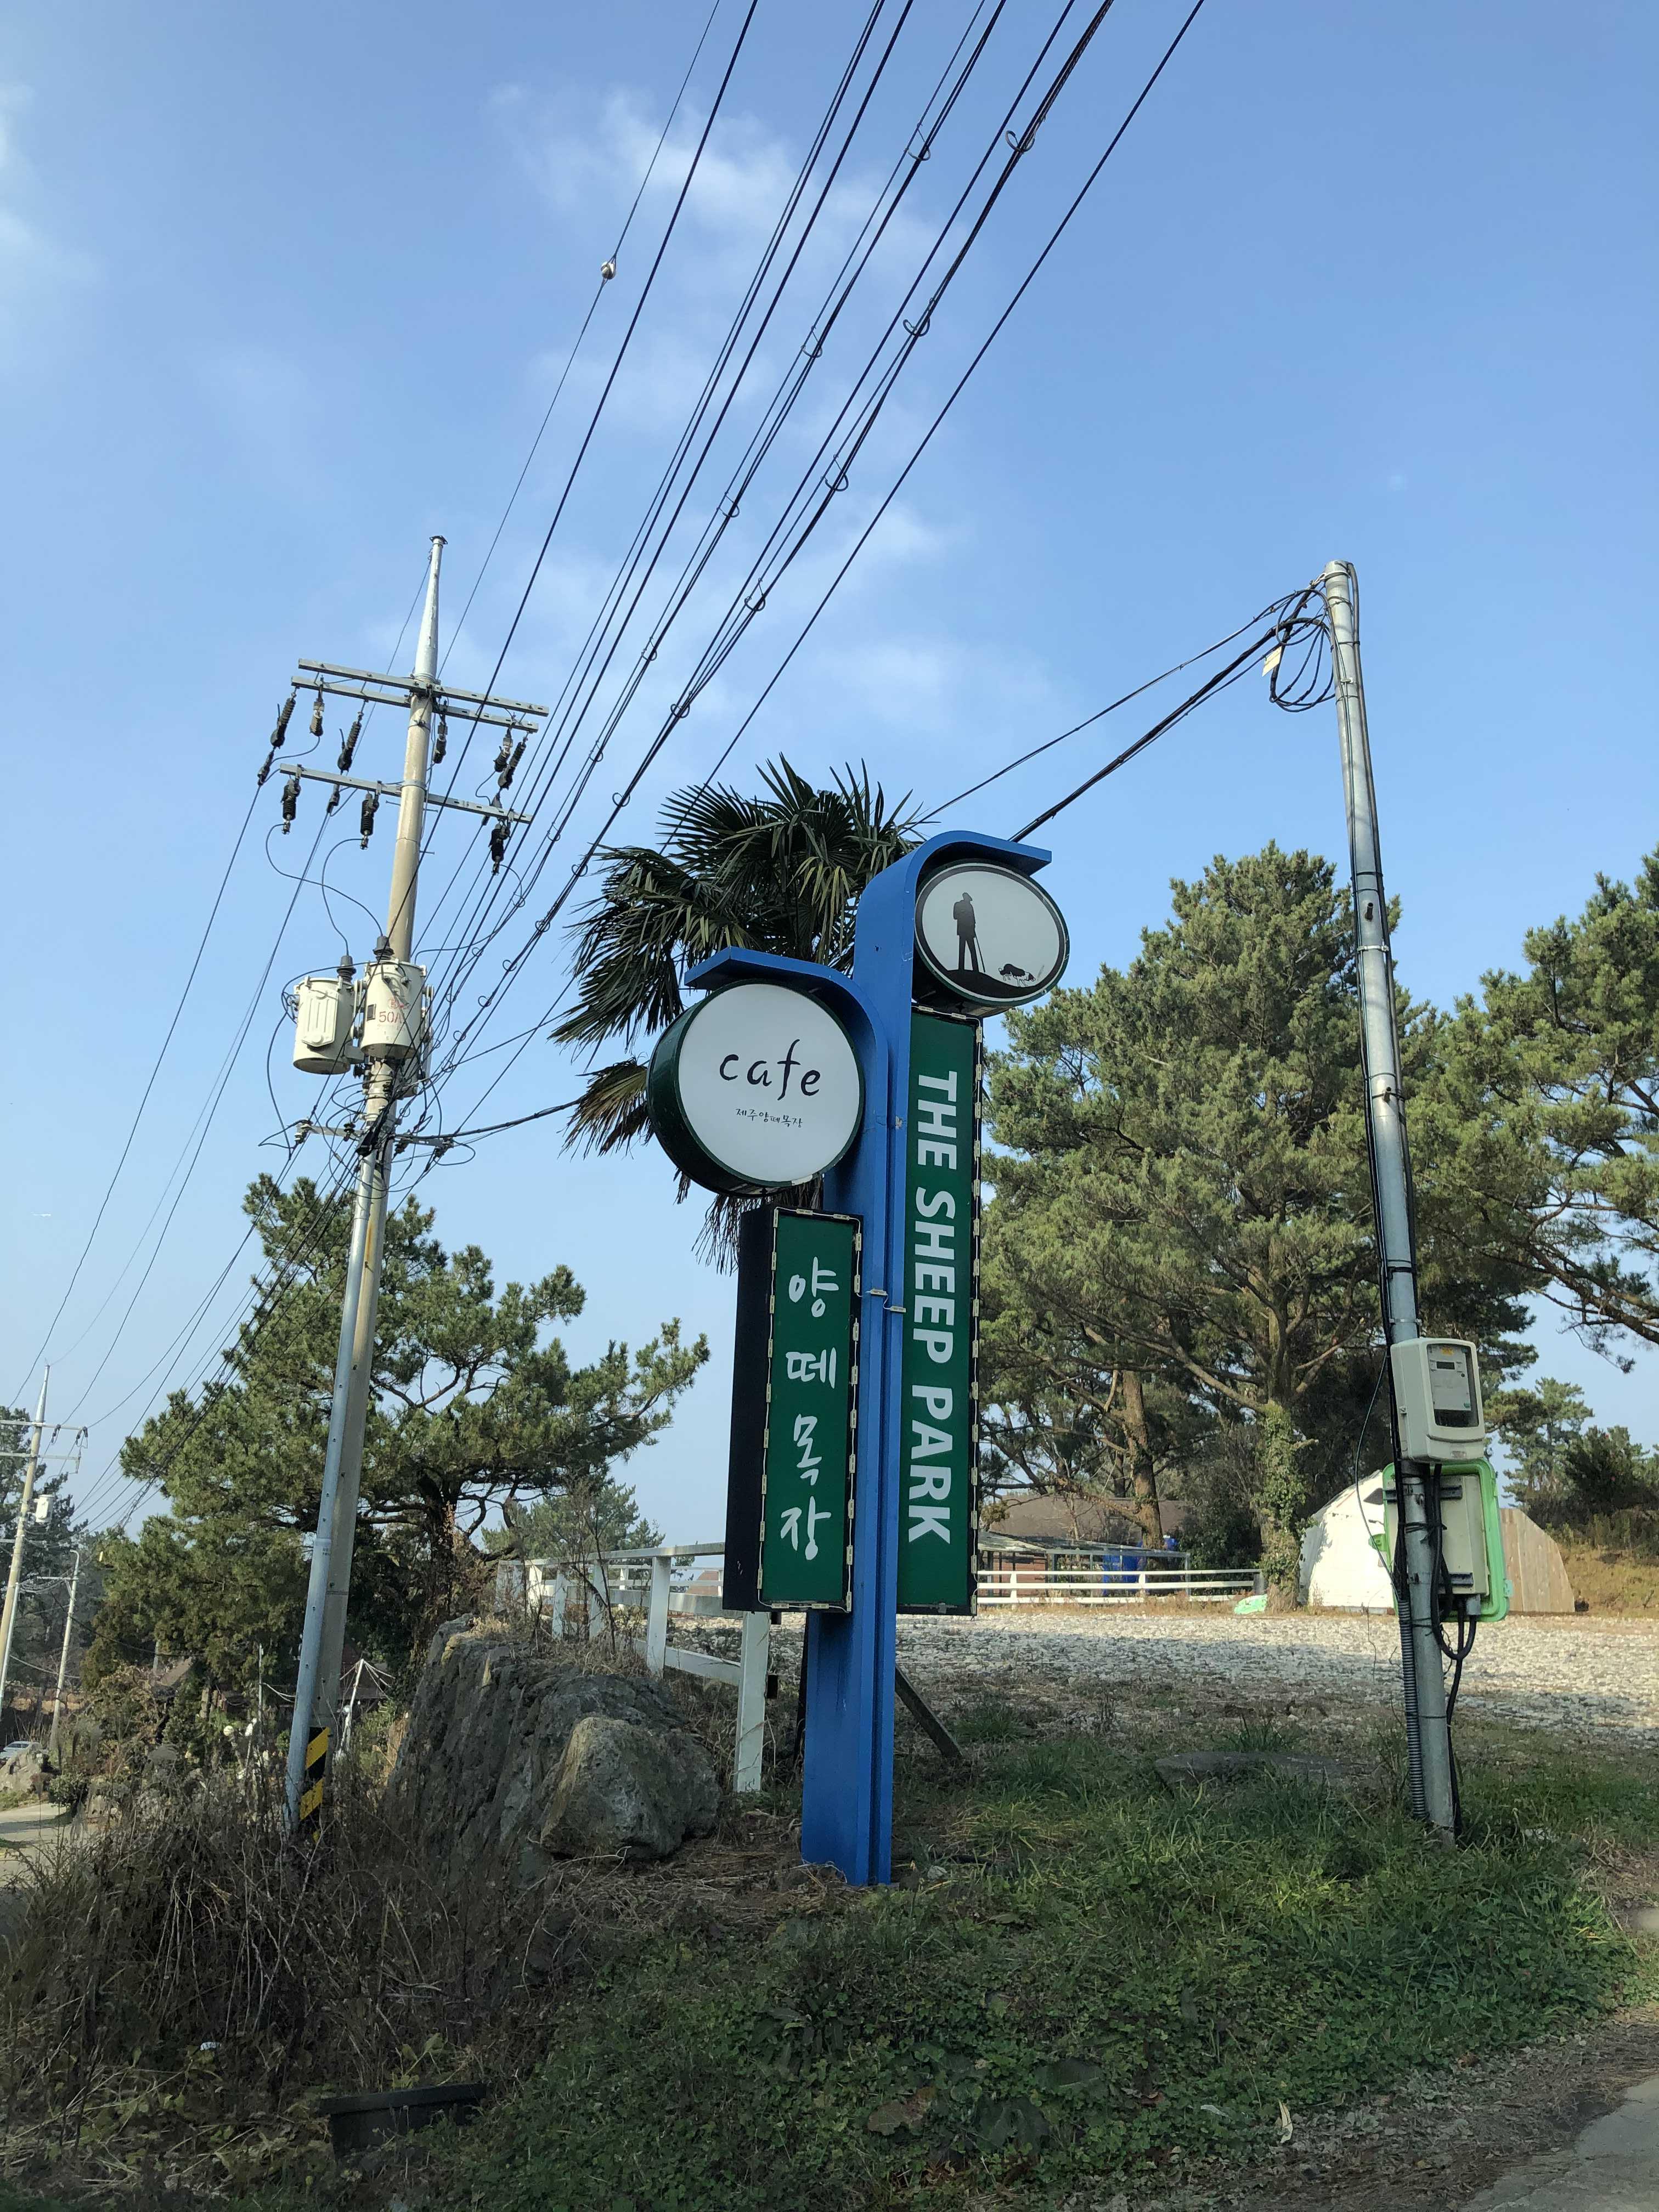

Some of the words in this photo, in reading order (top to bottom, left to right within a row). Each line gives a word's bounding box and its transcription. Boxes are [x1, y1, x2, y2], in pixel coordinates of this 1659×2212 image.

[719, 1039, 821, 1101] cafe
[736, 1108, 803, 1128] 제주양떼목장
[918, 1070, 957, 1170] THE
[913, 1186, 956, 1364] SHEEP
[780, 1256, 839, 1560] 양떼목장
[908, 1385, 953, 1544] PARK
